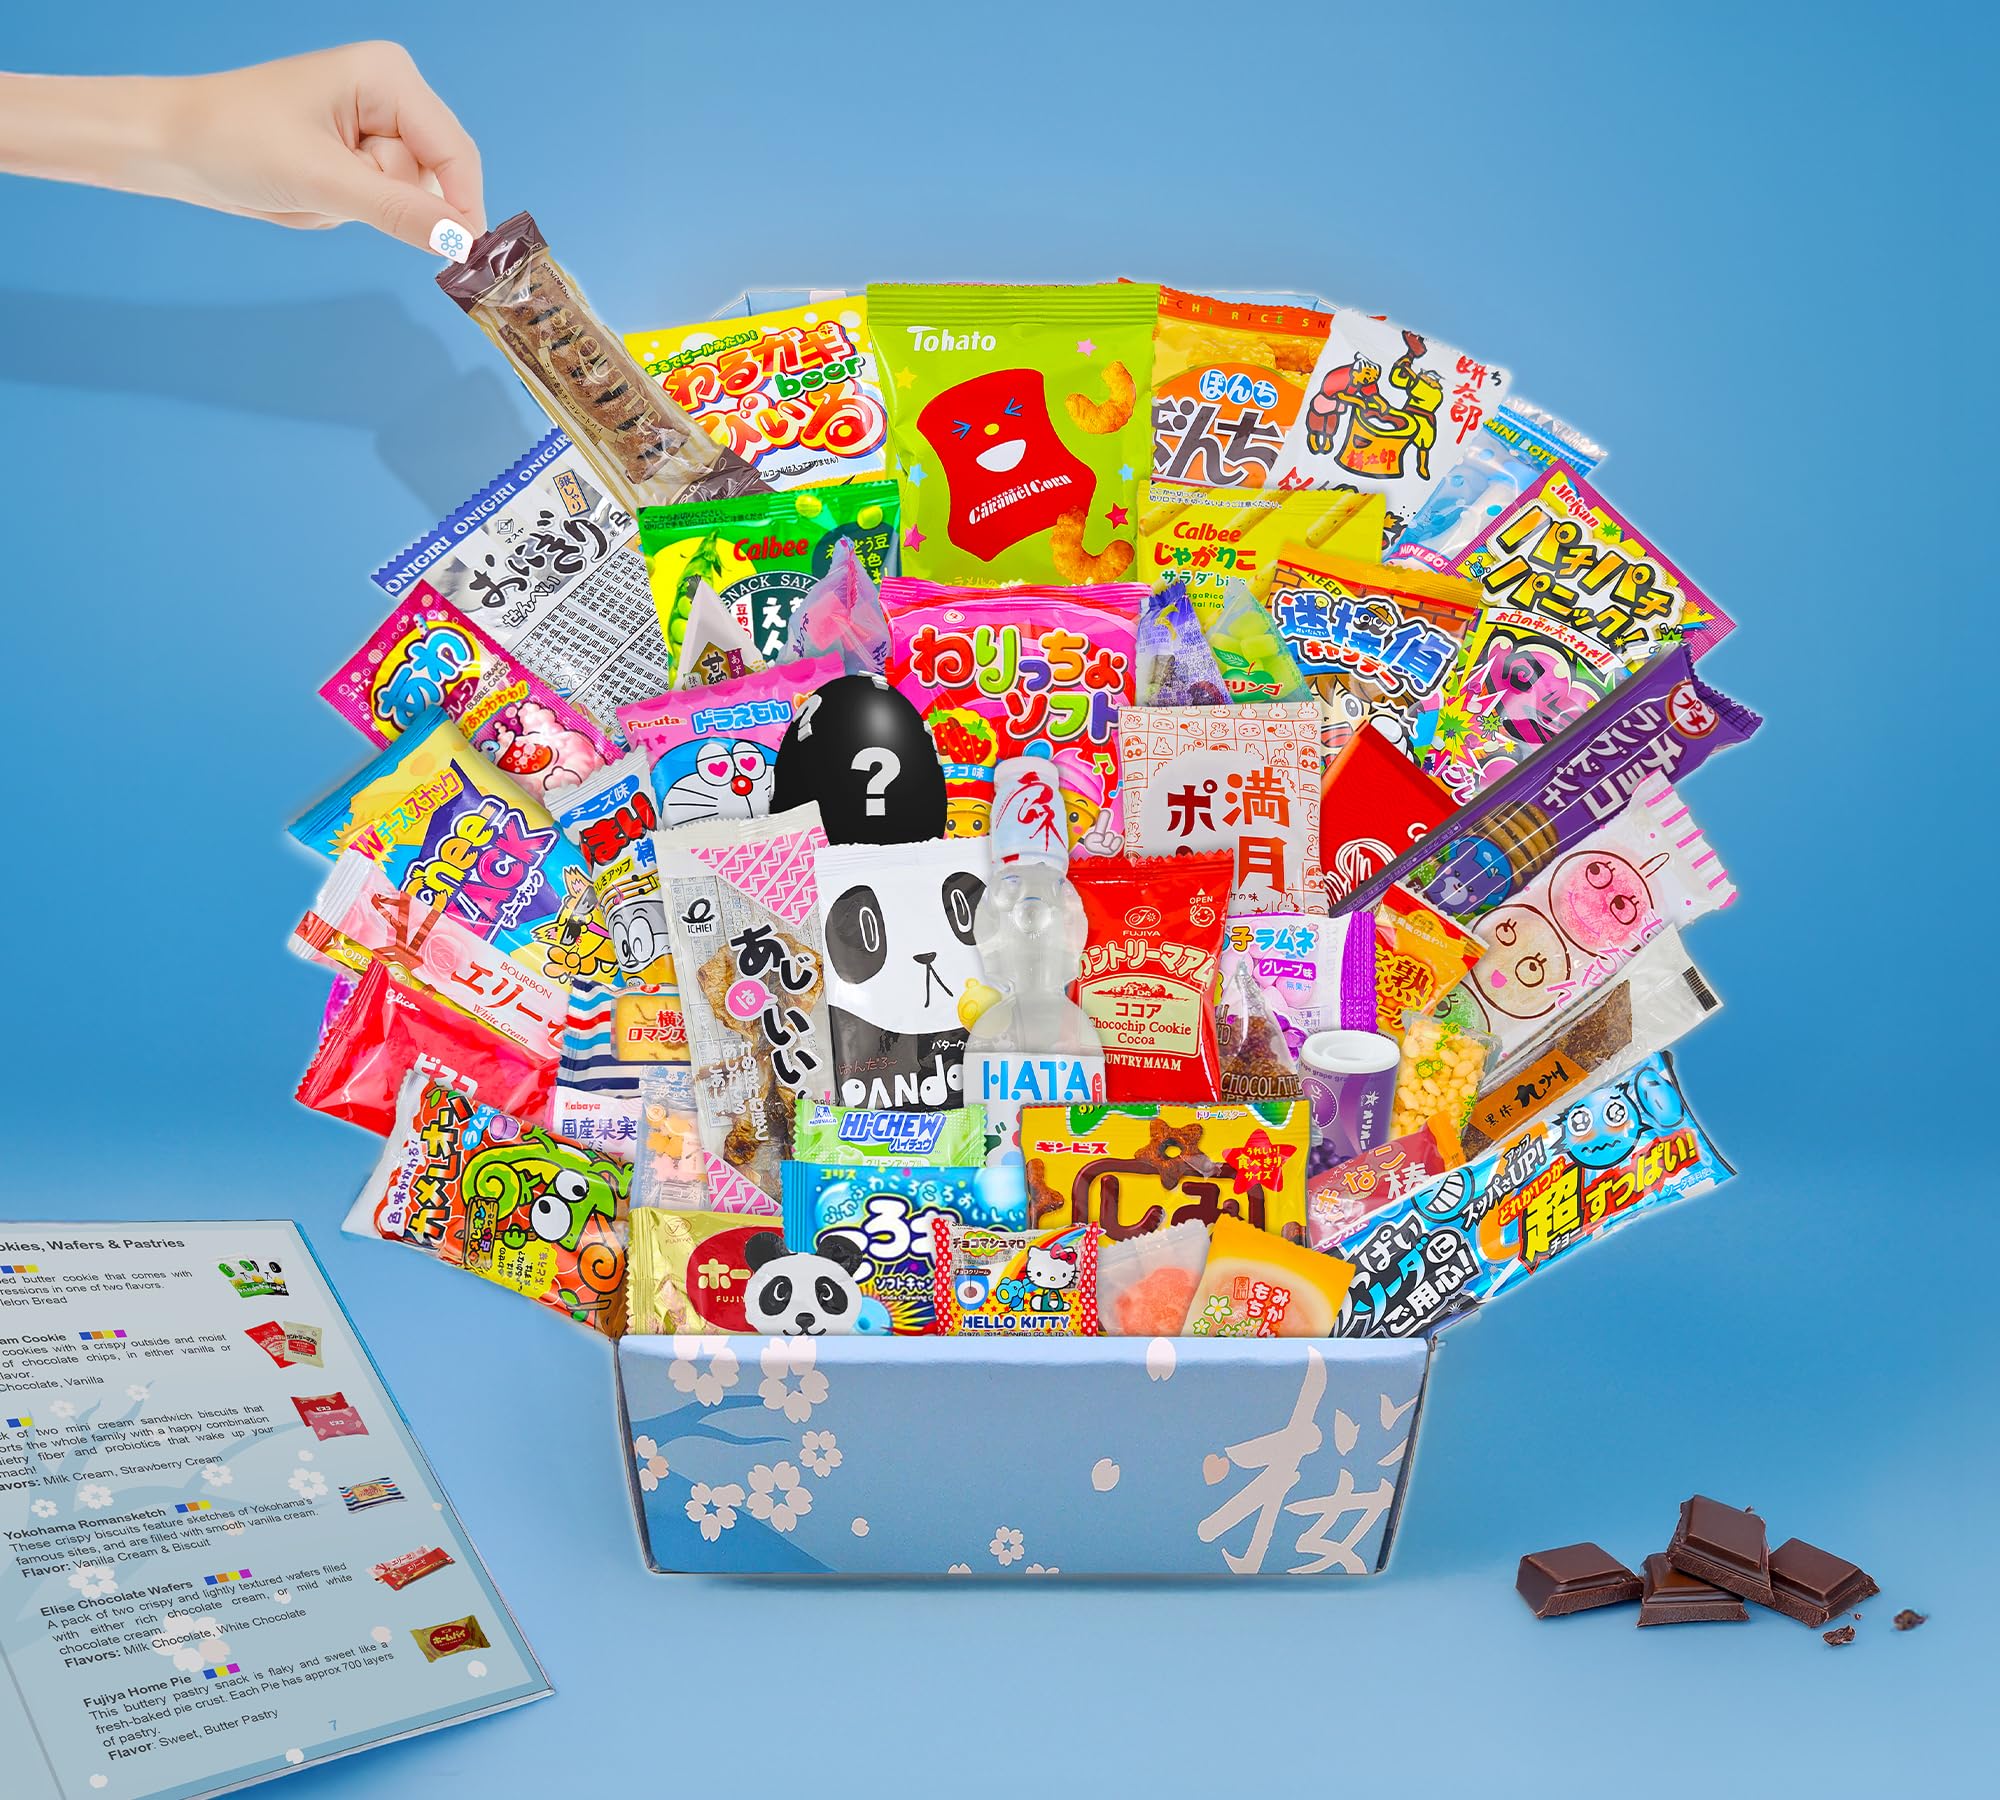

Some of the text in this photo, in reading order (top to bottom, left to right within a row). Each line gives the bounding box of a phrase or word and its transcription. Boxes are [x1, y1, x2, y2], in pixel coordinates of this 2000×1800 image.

[907, 326, 996, 351] Tohato
[775, 357, 862, 398] beer
[1200, 369, 1278, 409] ぼんち
[558, 474, 583, 512] 銀しゃり
[1551, 482, 1600, 530] Meisan
[385, 434, 572, 593] ONIGIRI ONIGIRI ONIGIR
[1173, 522, 1242, 542] Calbee
[469, 510, 608, 608] おにぎり
[733, 536, 809, 562] Calbee
[1154, 542, 1257, 570] じゃがりこ
[1497, 505, 1675, 618] パチパチ
[502, 577, 560, 628] せんべい
[483, 660, 503, 681] GRAPE
[467, 663, 511, 711] BUBBLE CANDY
[628, 715, 680, 732] Furuta
[693, 701, 792, 733] ドラえもん
[1005, 692, 1119, 741] ソフト
[571, 783, 630, 819] チーズ味
[1190, 895, 1213, 904] OPEN
[687, 924, 712, 933] ICHIEI
[1122, 929, 1160, 937] FUJIYA
[500, 961, 552, 999] BOURBON
[385, 987, 420, 1012] Glico
[1115, 1002, 1162, 1018] ココア
[473, 1004, 529, 1044] White Cream
[1149, 1021, 1192, 1036] Cookie
[1117, 1033, 1155, 1046] Cocoa
[984, 1061, 1091, 1100] HATA
[1221, 1073, 1302, 1097] CHOCOLATE
[1312, 1069, 1332, 1081] grape
[562, 1117, 637, 1141] 国産果実
[840, 1112, 944, 1139] HI-CHEW
[1036, 1141, 1109, 1154] ギンビス
[1237, 1154, 1283, 1170] 食べきり
[1244, 1169, 1272, 1181] サイズ
[1525, 1168, 1581, 1261] 超
[46, 1239, 184, 1250] Wafers & Pastries
[21, 1270, 193, 1284] butter cookie that comes with
[963, 1316, 1070, 1329] HELLO KITTY
[2, 1344, 48, 1356] cookies
[51, 1343, 77, 1353] with
[90, 1340, 127, 1353] crispy
[130, 1337, 170, 1347] outside
[174, 1335, 197, 1344] and
[196, 1334, 227, 1343] moist
[42, 1455, 223, 1485] Milk Cream, Strawberry Cream
[3, 1509, 166, 1540] Yokohama Romansketch
[12, 1498, 312, 1552] These crispy biscuits feature sketches of Yokohama's
[21, 1538, 211, 1578] Flavor: Vanilla Cream & Biscuit
[40, 1581, 193, 1616] Elise Chocolate Wafers
[64, 1609, 306, 1668] Flavors: Milk Chocolate, White Chocolate
[83, 1674, 192, 1708] Fujiya Home Pie
[96, 1653, 394, 1734] fresh-baked pie crust. Each Pie has approx 700 layers
[108, 1709, 278, 1760] Flavor: Sweet, Butter Pastry
[328, 1719, 337, 1731] 7
